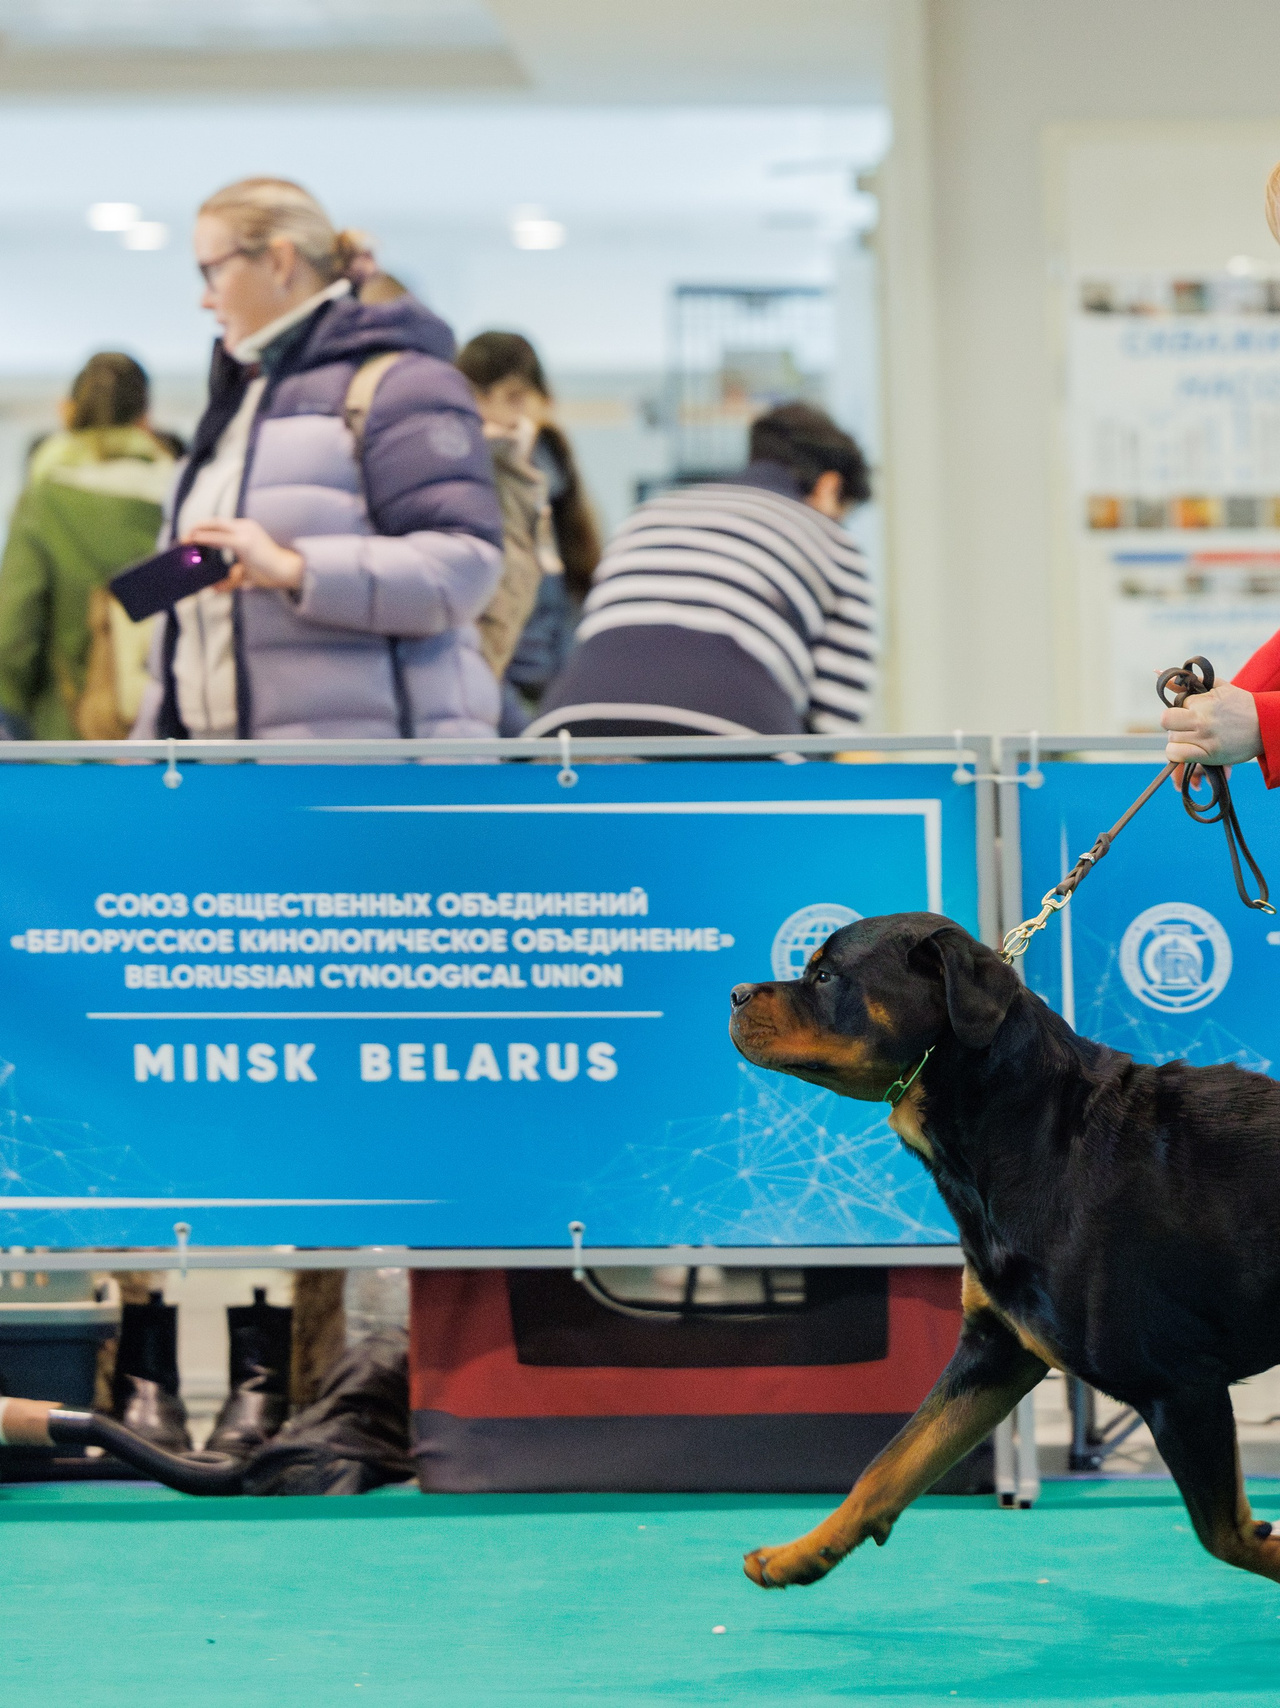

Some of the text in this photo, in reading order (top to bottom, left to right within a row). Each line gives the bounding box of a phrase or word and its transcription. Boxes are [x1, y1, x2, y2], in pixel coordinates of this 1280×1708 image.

[95, 885, 649, 922] СОЮЗ ОБЩЕСТВЕННЫХ ОБЪЕДИНЕНИЙ
[10, 926, 735, 957] «БЕЛОРУССКОЕ КИНОЛОГИЧЕСКОЕ ОБЪЕДИНЕНИЕ»
[124, 963, 624, 990] BELORUSSIAN CYNOLOGICAL UNION
[133, 1041, 619, 1084] MINSK BELARUS
